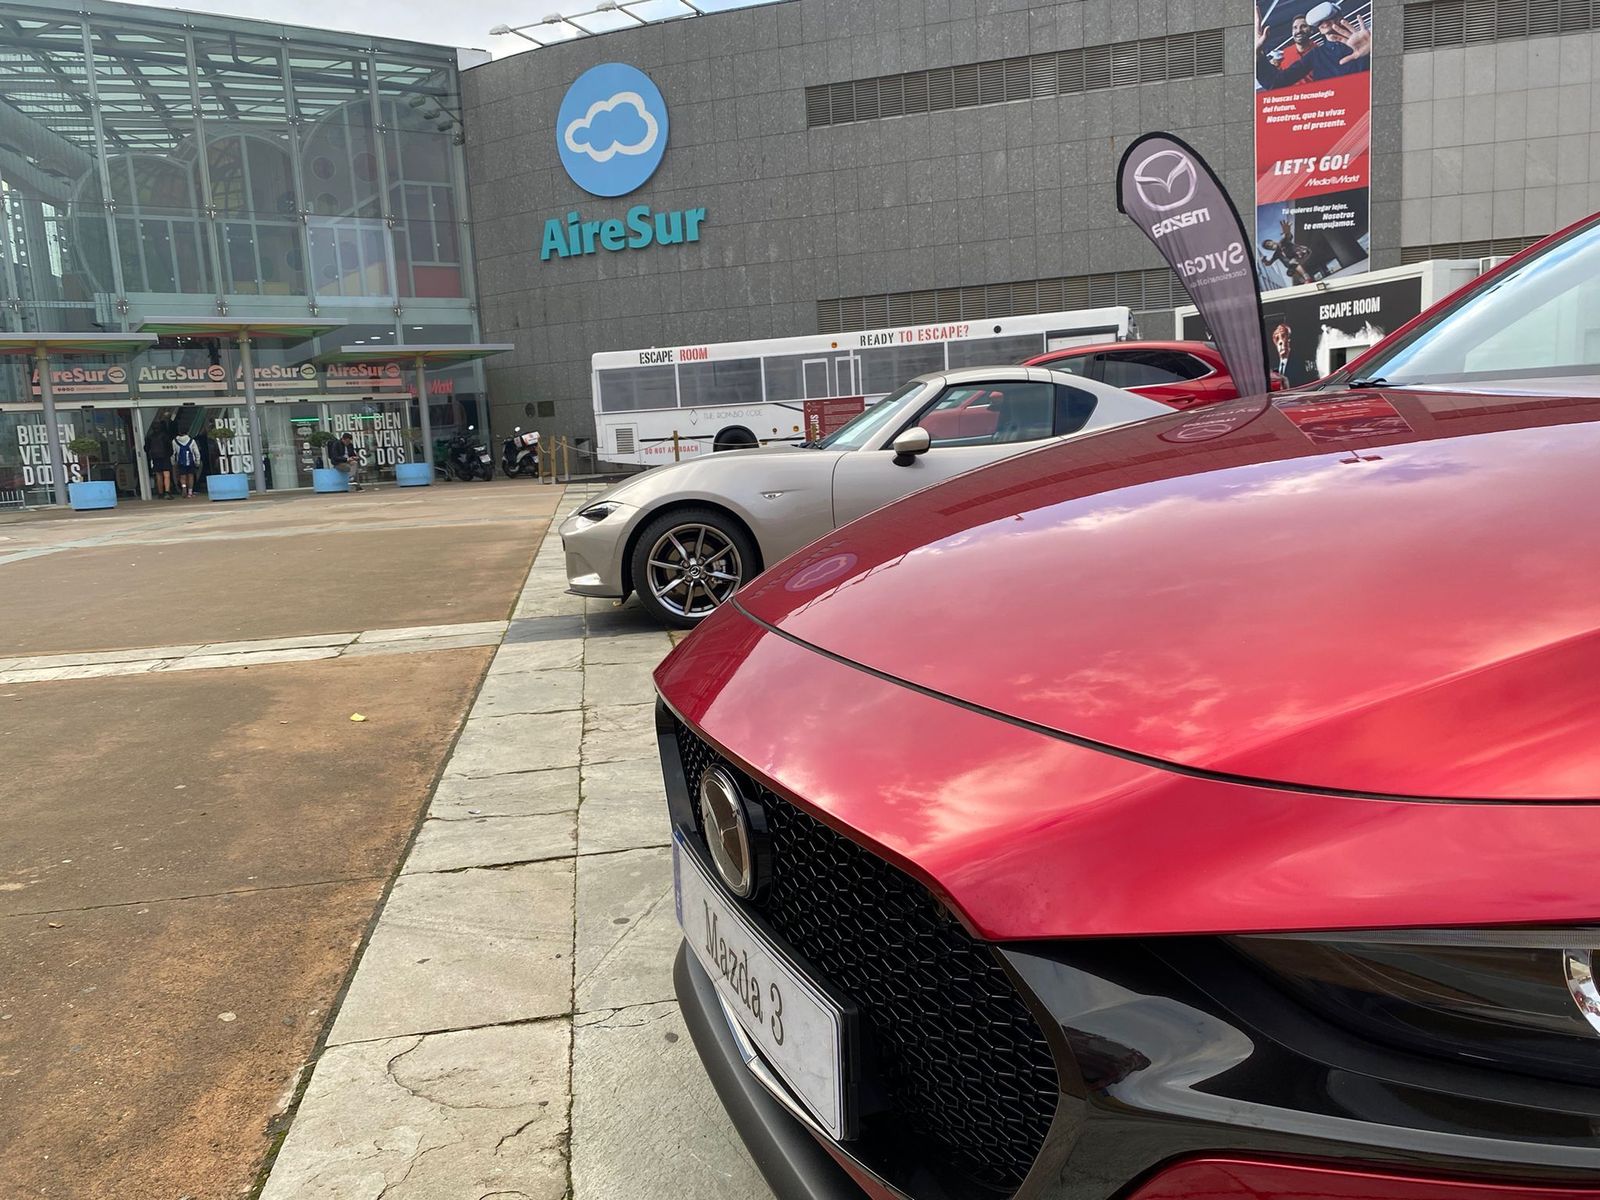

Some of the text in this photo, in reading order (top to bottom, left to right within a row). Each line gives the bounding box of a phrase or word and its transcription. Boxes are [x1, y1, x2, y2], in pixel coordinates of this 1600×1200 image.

[1266, 114, 1302, 123] Nosotros,
[1302, 112, 1317, 120] que
[1325, 109, 1346, 117] vivas
[1311, 119, 1347, 130] presente.
[1274, 154, 1350, 176] LET'S GO!
[1322, 212, 1355, 220] Nosotros
[540, 204, 707, 261] AireSur
[1303, 222, 1311, 230] te
[1319, 296, 1381, 320] ESCAPE ROOM
[860, 324, 970, 347] READY TO ESCAPE?
[639, 347, 708, 365] ESCAPE ROOM
[139, 366, 207, 381] AireSur
[326, 363, 386, 377] AireSur
[373, 412, 401, 430] BIEN
[374, 429, 403, 448] VENI
[376, 447, 405, 465] DOS
[703, 898, 784, 1046] Mazda 3
